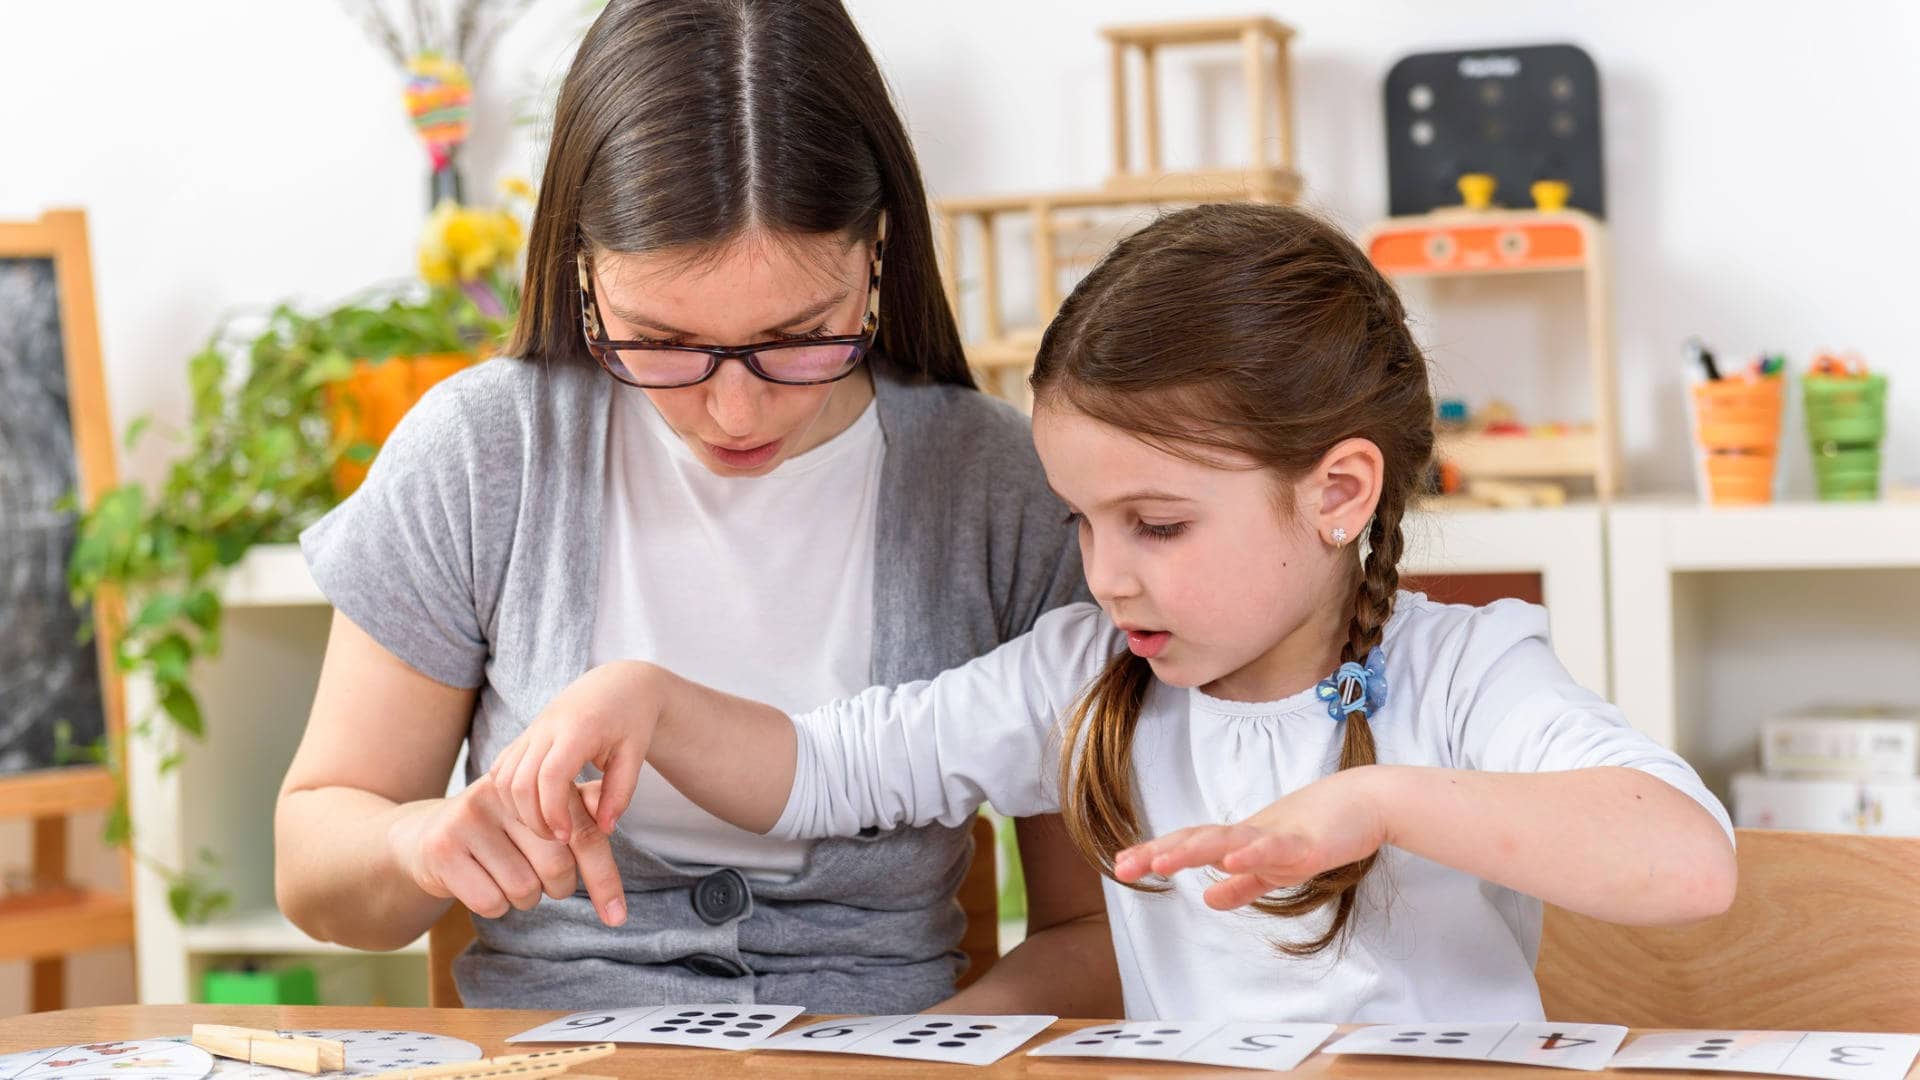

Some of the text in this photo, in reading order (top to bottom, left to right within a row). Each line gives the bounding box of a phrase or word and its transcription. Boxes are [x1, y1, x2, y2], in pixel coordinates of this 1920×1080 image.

[550, 1016, 615, 1032] 9
[802, 1023, 871, 1039] 6
[1229, 1034, 1294, 1052] 5
[1538, 1033, 1597, 1050] 4
[1828, 1046, 1885, 1066] 3
